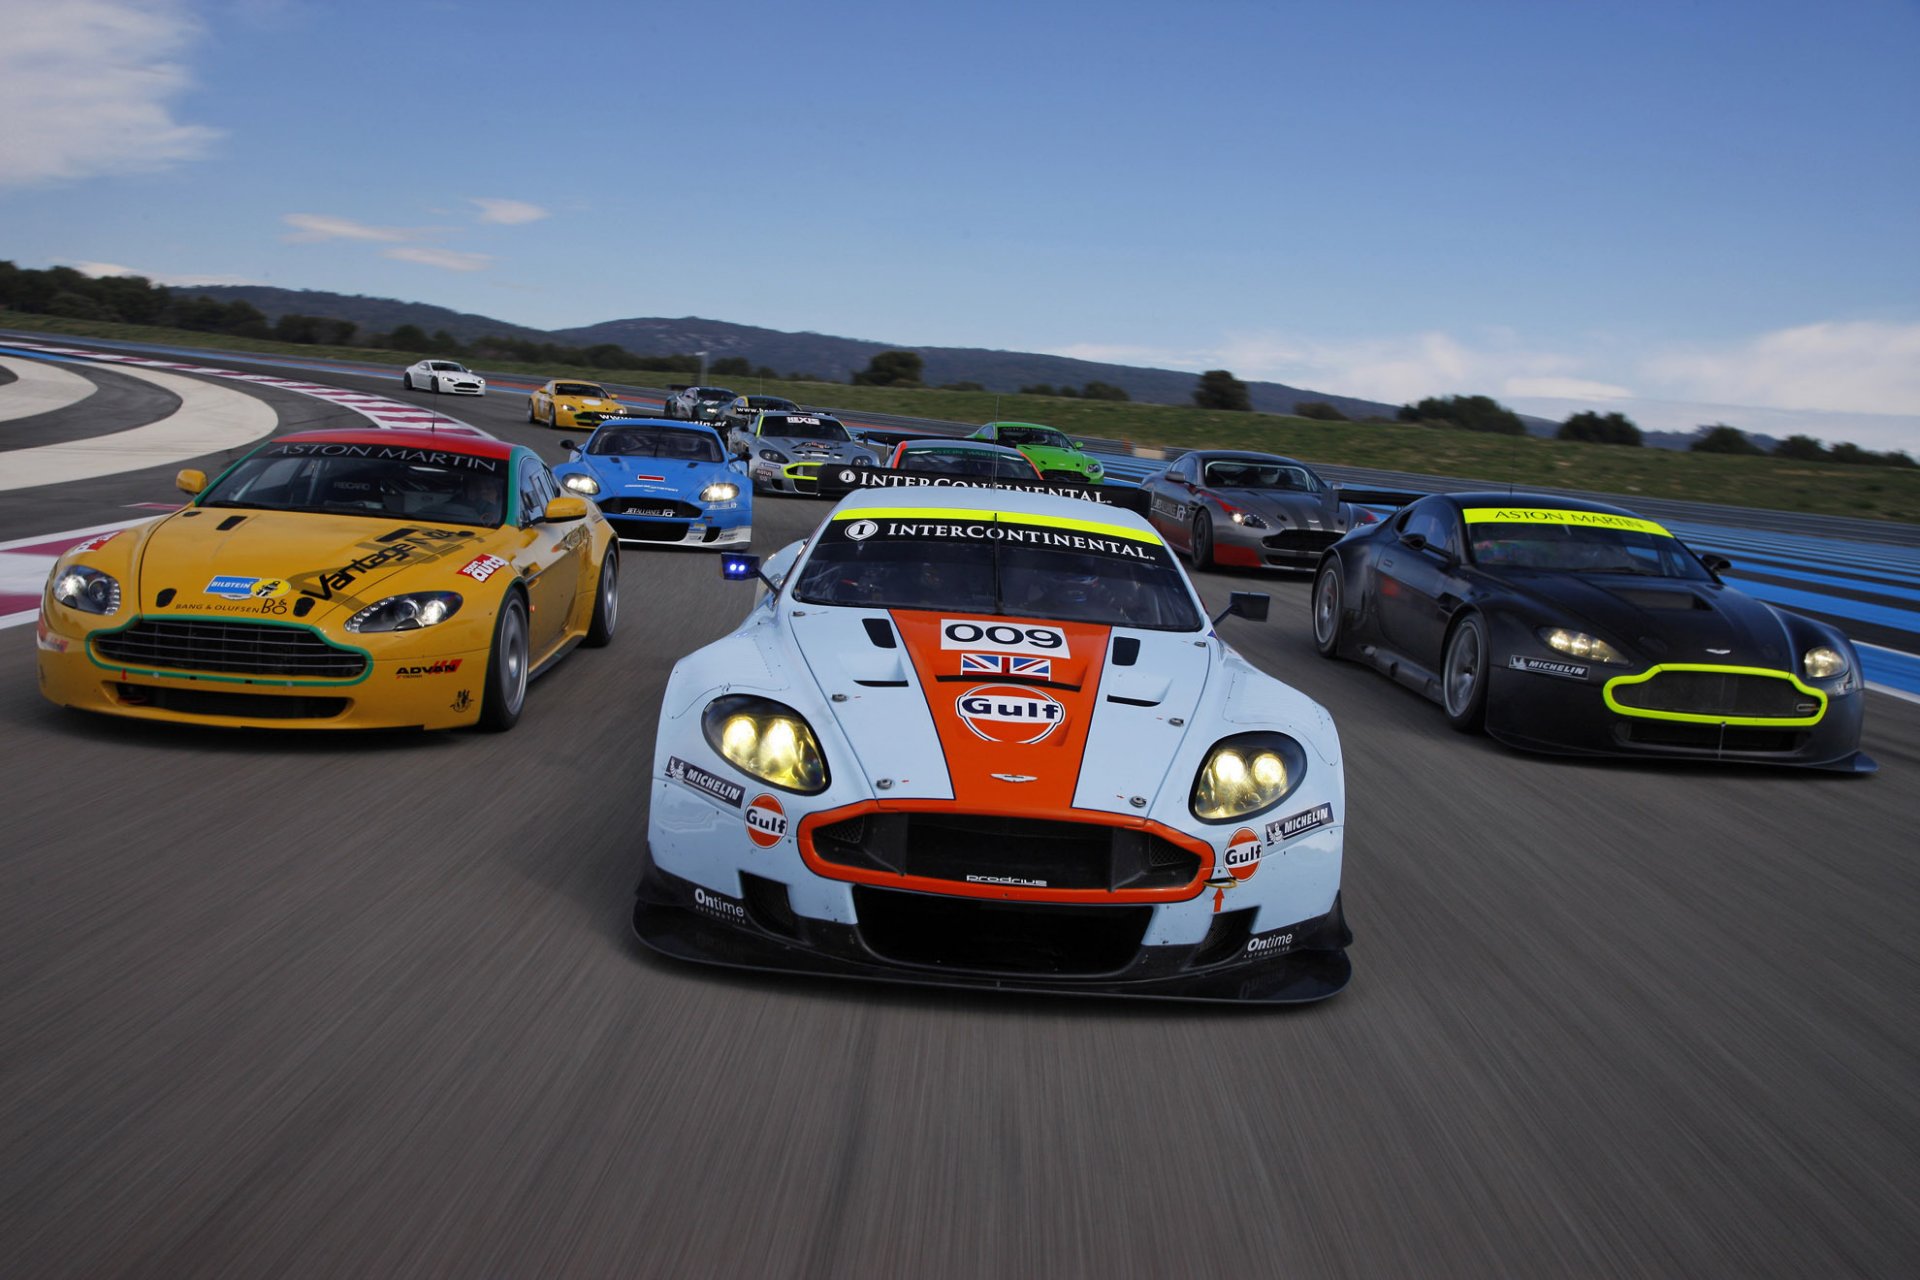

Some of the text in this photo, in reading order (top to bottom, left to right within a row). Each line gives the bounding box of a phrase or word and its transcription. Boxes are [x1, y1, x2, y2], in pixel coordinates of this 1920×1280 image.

[269, 444, 496, 472] ASTON MARTIN
[1495, 510, 1644, 529] ASTON MARTIN
[887, 522, 1151, 560] INTERCONTINENTAL
[300, 543, 416, 601] Vantage
[471, 555, 508, 583] auto
[211, 581, 251, 589] BILSTEIN
[214, 604, 260, 613] OLUFSEN
[945, 623, 1063, 649] 009
[396, 664, 457, 675] ADVAN
[1528, 659, 1586, 675] MICHELIN
[961, 697, 1059, 720] Gulf
[686, 768, 741, 801] MICHELIN
[746, 808, 786, 834] Gulf
[1283, 807, 1328, 834] MICHELIN
[1225, 844, 1262, 865] Gulf
[694, 888, 744, 918] Ontime
[1247, 932, 1293, 952] Ontime
